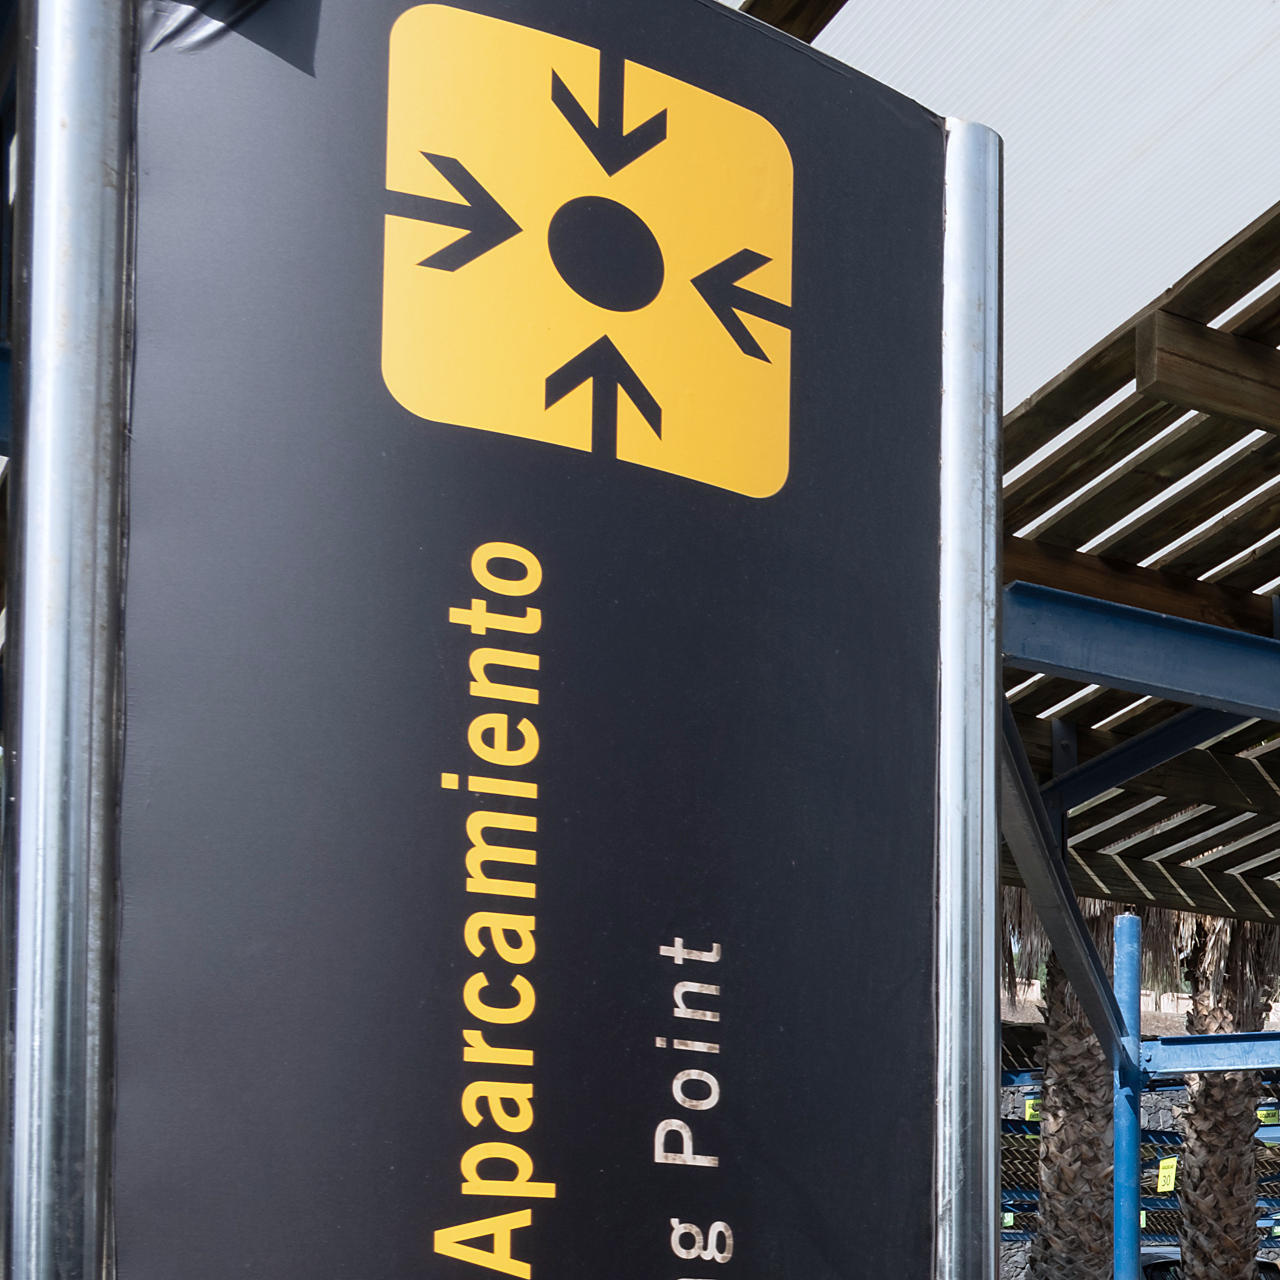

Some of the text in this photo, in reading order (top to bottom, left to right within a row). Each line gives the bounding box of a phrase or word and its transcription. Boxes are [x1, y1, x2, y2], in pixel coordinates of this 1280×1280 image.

[434, 542, 556, 1280] Aparcamiento
[653, 936, 722, 1167] Point
[1161, 1175, 1171, 1187] 30
